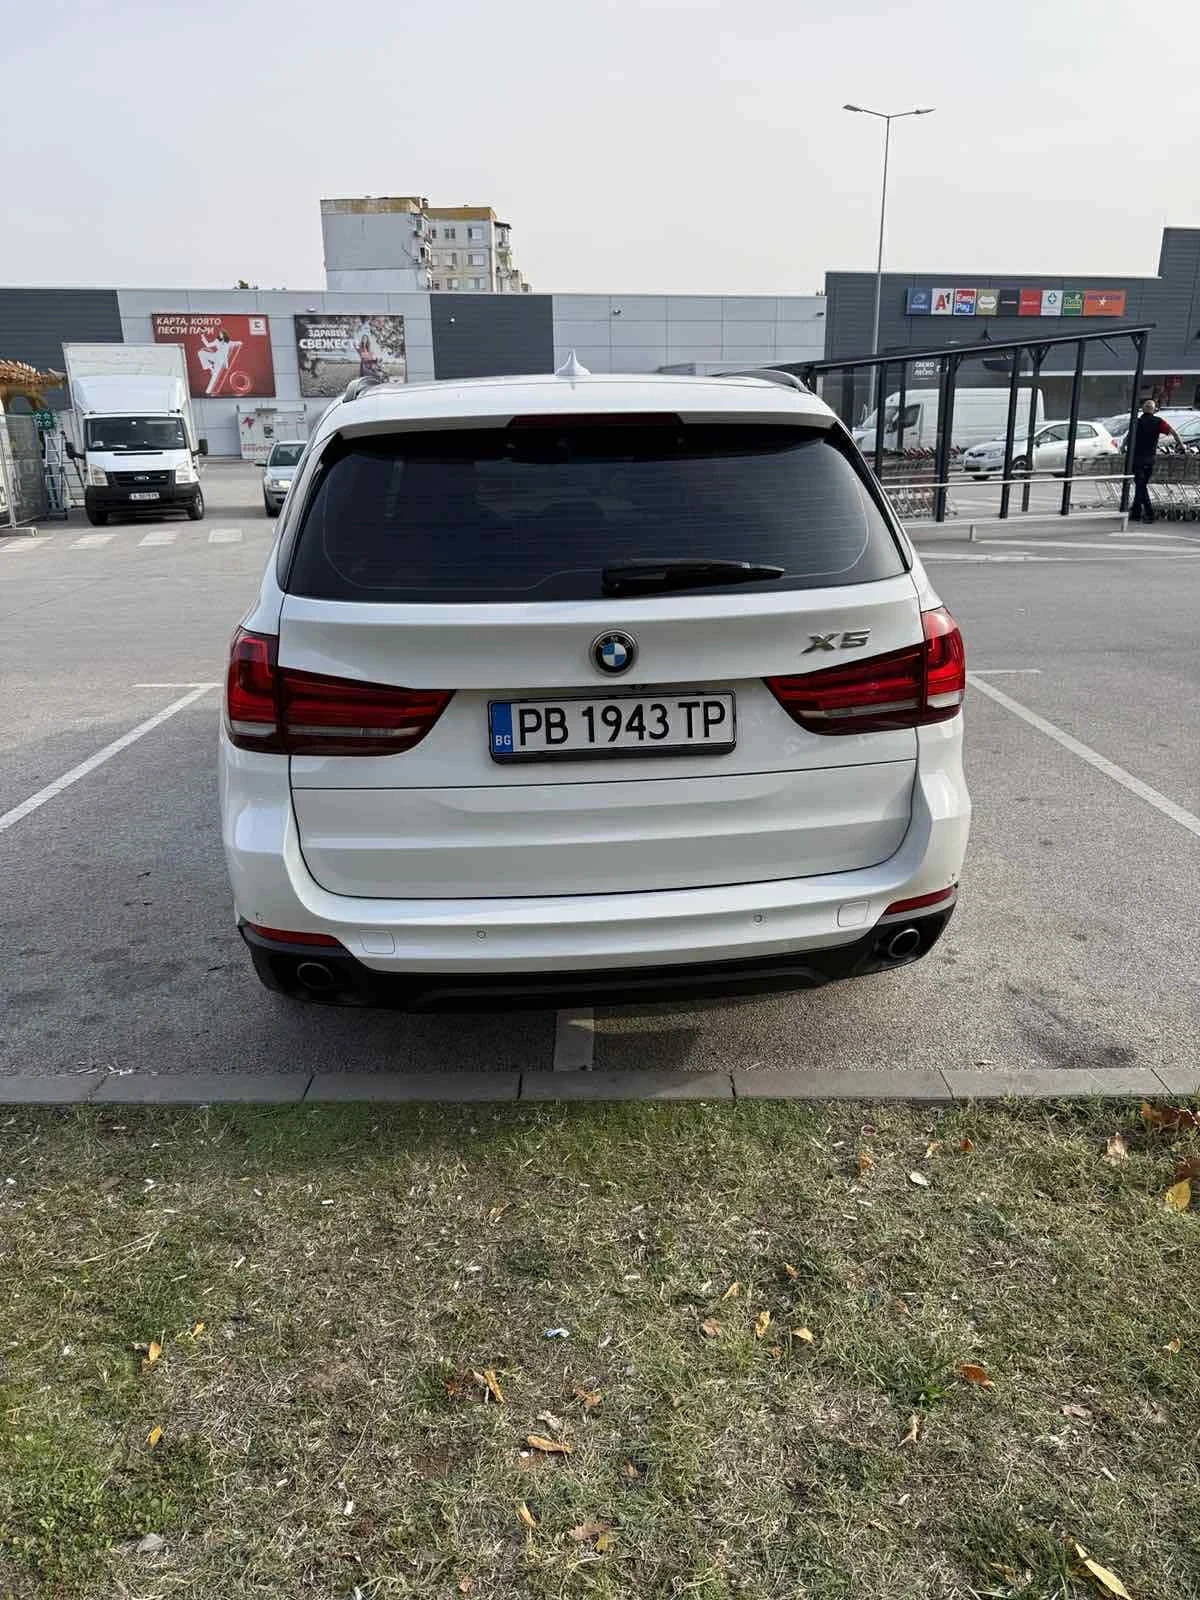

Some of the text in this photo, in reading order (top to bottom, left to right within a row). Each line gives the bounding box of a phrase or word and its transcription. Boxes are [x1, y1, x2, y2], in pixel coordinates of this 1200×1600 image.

[935, 292, 951, 310] A1
[156, 316, 222, 326] КАРТА, КОЯТО
[158, 326, 188, 335] ПЕСТИ
[802, 628, 871, 655] X5
[518, 700, 727, 746] PB 1943 TP
[495, 734, 512, 746] BG
